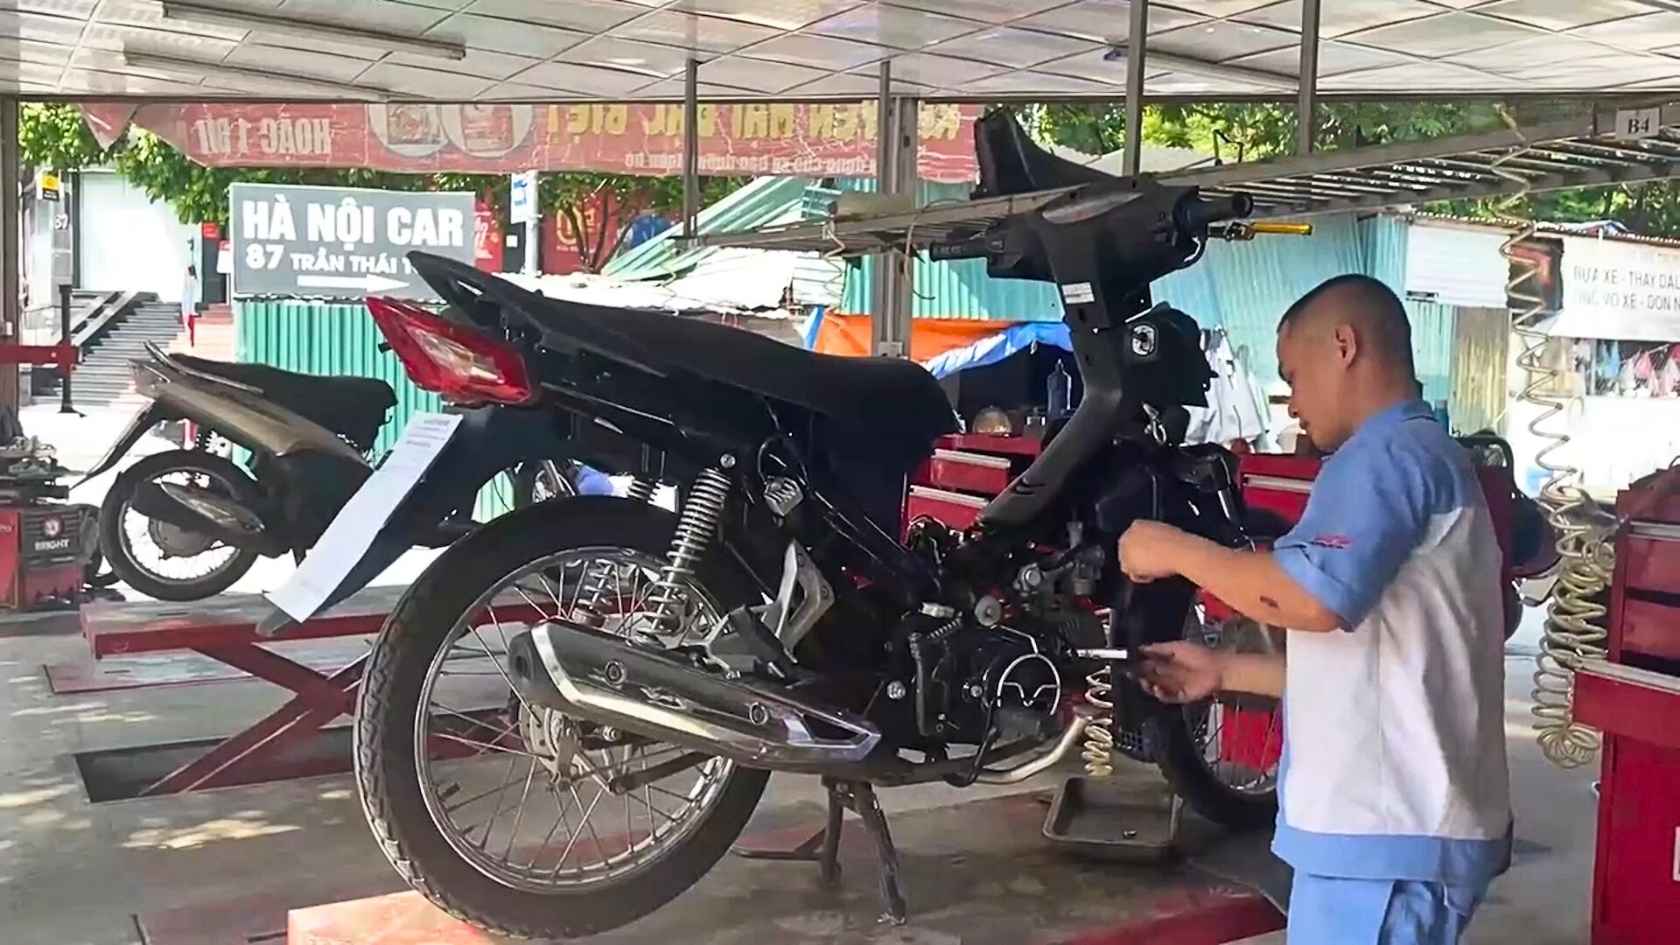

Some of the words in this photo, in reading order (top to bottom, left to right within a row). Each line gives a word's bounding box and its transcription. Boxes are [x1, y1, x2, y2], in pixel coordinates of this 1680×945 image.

[1628, 116, 1650, 134] B4
[242, 194, 297, 241] HÀ
[307, 196, 375, 251] NỘI
[386, 206, 464, 247] CAR
[246, 243, 285, 270] 87
[349, 253, 397, 275] THÁI
